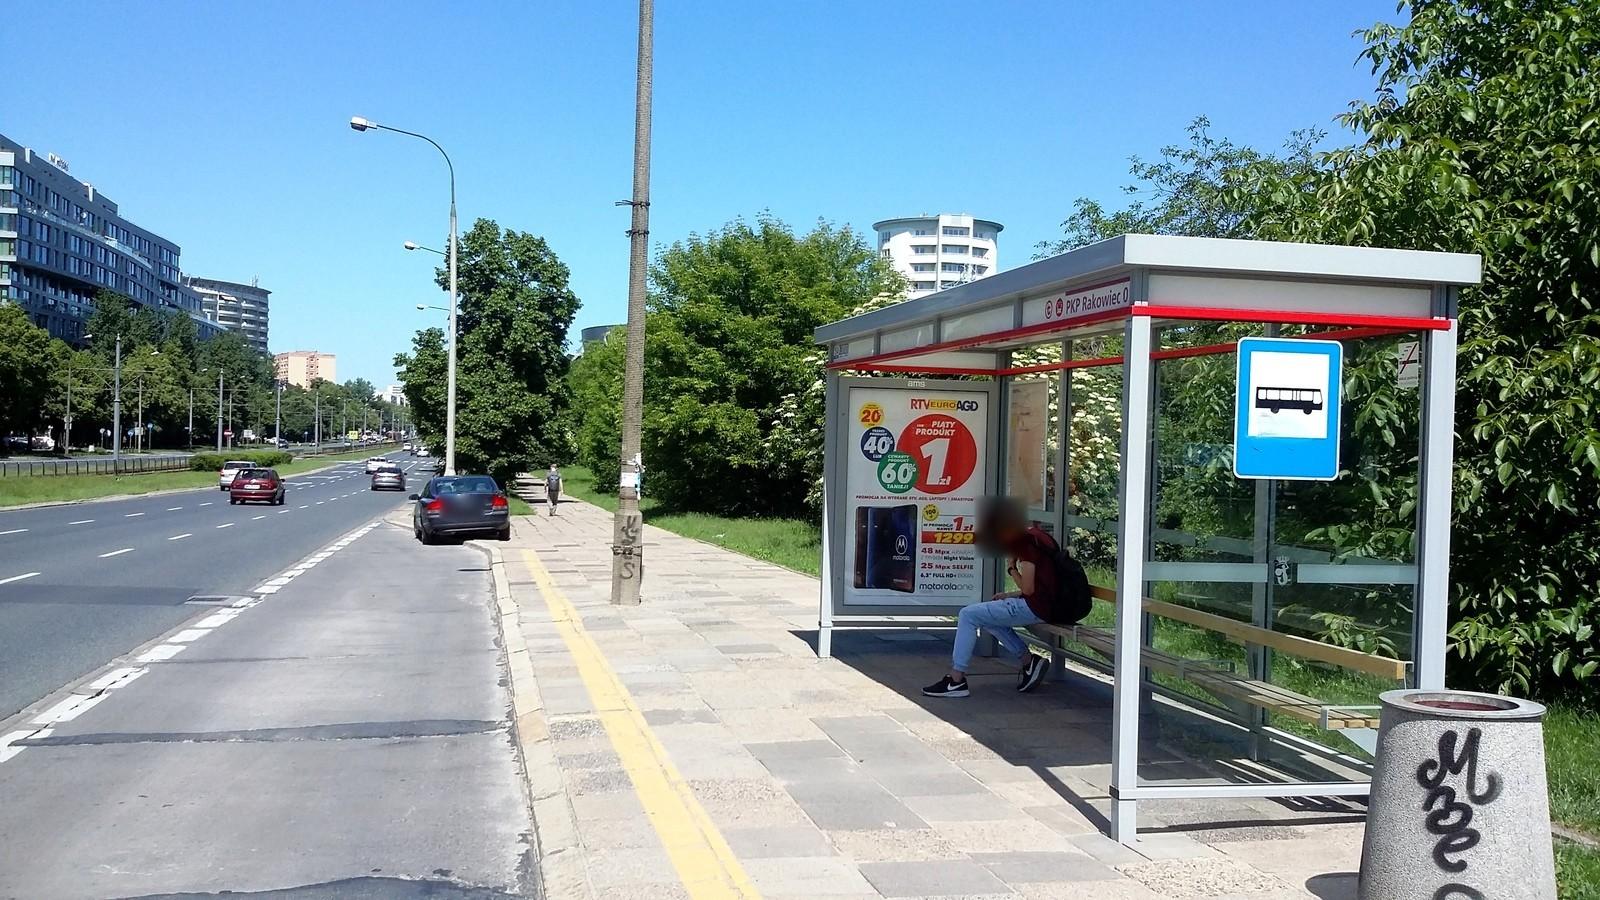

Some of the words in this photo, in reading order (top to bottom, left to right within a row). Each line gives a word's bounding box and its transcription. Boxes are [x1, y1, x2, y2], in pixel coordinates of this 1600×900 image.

[1066, 298, 1080, 315] PKP
[1082, 290, 1120, 311] Rakowiec
[907, 380, 926, 388] ams
[915, 428, 956, 436] PRODUKT
[935, 532, 974, 543] 1299
